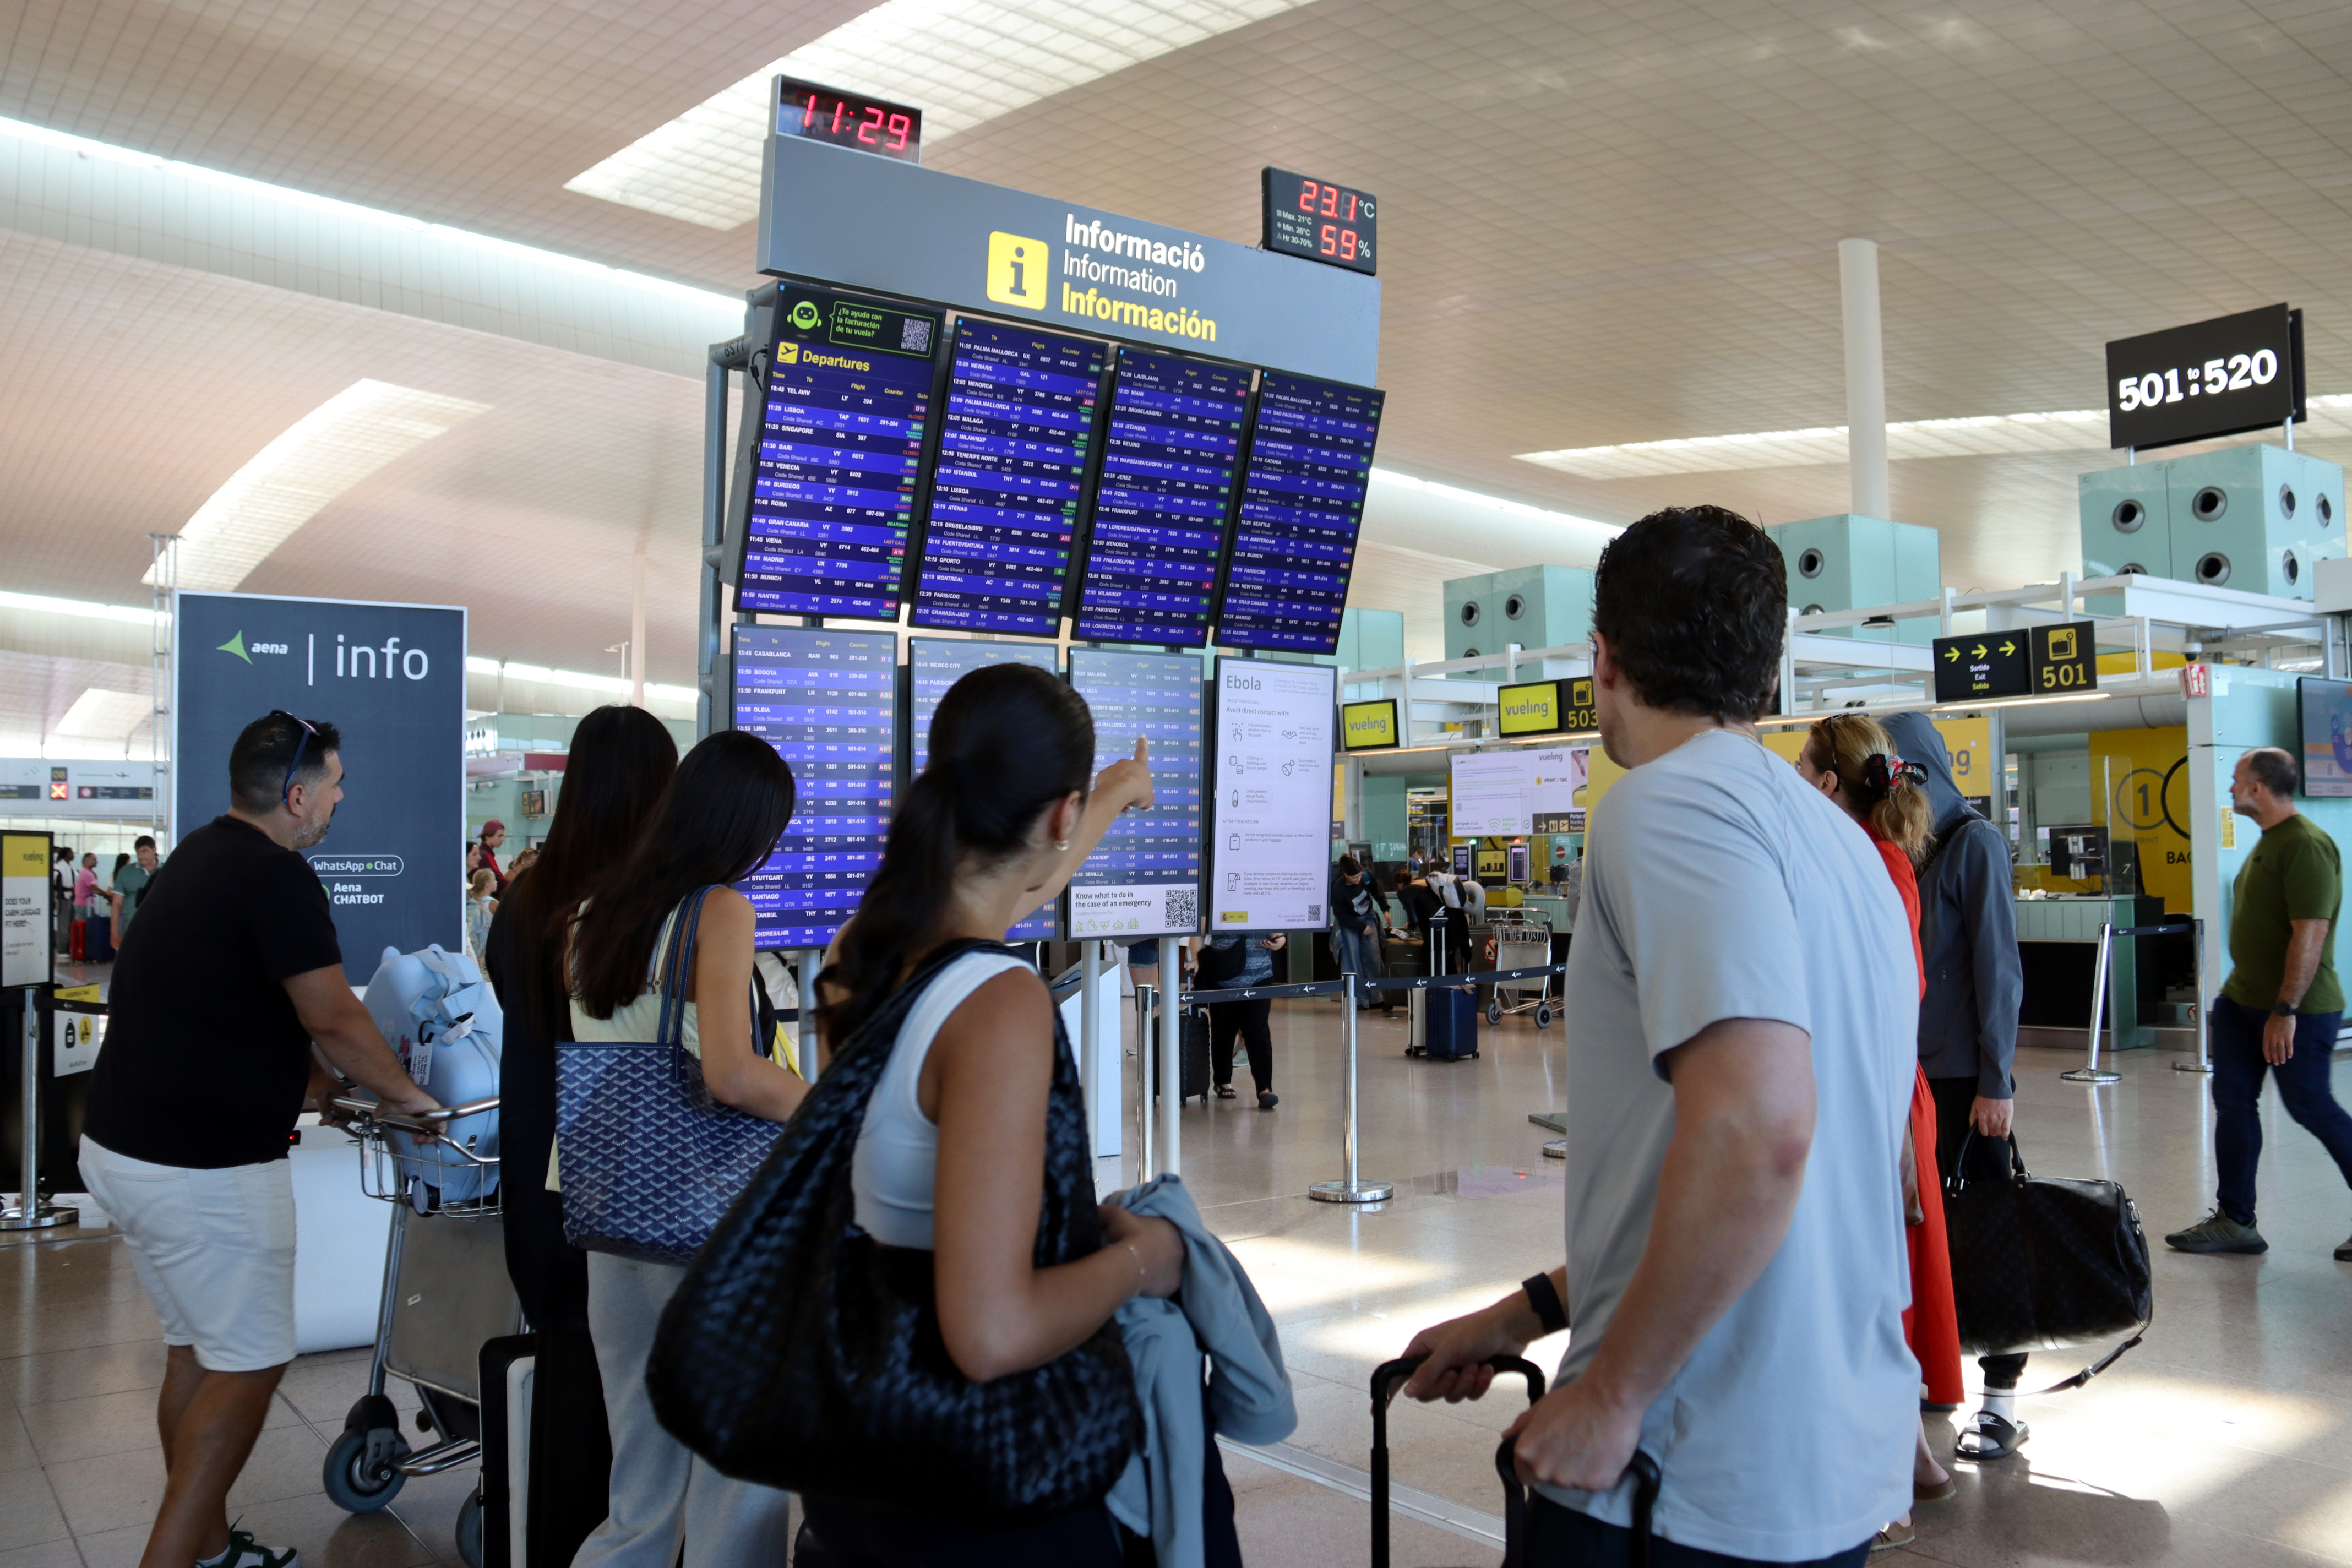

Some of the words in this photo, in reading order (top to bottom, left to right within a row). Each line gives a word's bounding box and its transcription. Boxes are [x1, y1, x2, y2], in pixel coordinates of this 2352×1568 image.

[804, 95, 910, 150] 11:29
[1299, 181, 1358, 221] 23.1
[1283, 211, 1296, 221] Max.
[1283, 223, 1294, 232] Min.
[1065, 214, 1204, 273] Informació
[1321, 224, 1357, 260] 59
[1064, 249, 1177, 298] Information
[839, 308, 849, 316] ¿Te
[851, 310, 869, 319] ayudo
[1062, 282, 1216, 341] Información
[845, 318, 880, 329] facturación
[854, 329, 874, 337] vuelo?
[973, 344, 990, 353] PALMA
[991, 347, 1018, 357] MALLORCA
[803, 350, 870, 372] Departures
[2119, 368, 2184, 411] 501
[2187, 367, 2200, 380] to
[2204, 349, 2278, 394] 520
[251, 641, 288, 654] aena
[337, 635, 428, 680] info
[1970, 663, 1990, 673] Sortida
[2042, 663, 2087, 688] 501
[1227, 675, 1261, 691] Ebola
[1972, 682, 1990, 690] Salida
[1506, 699, 1548, 717] vueling
[1349, 716, 1386, 733] vueling
[1568, 710, 1597, 728] 503
[1539, 752, 1563, 762] vueling
[2138, 783, 2148, 816] 1
[2167, 852, 2191, 864] BA
[314, 861, 364, 872] WhatsApp
[374, 861, 396, 870] Chat
[334, 883, 361, 892] Aena
[334, 894, 384, 905] CHATBOT
